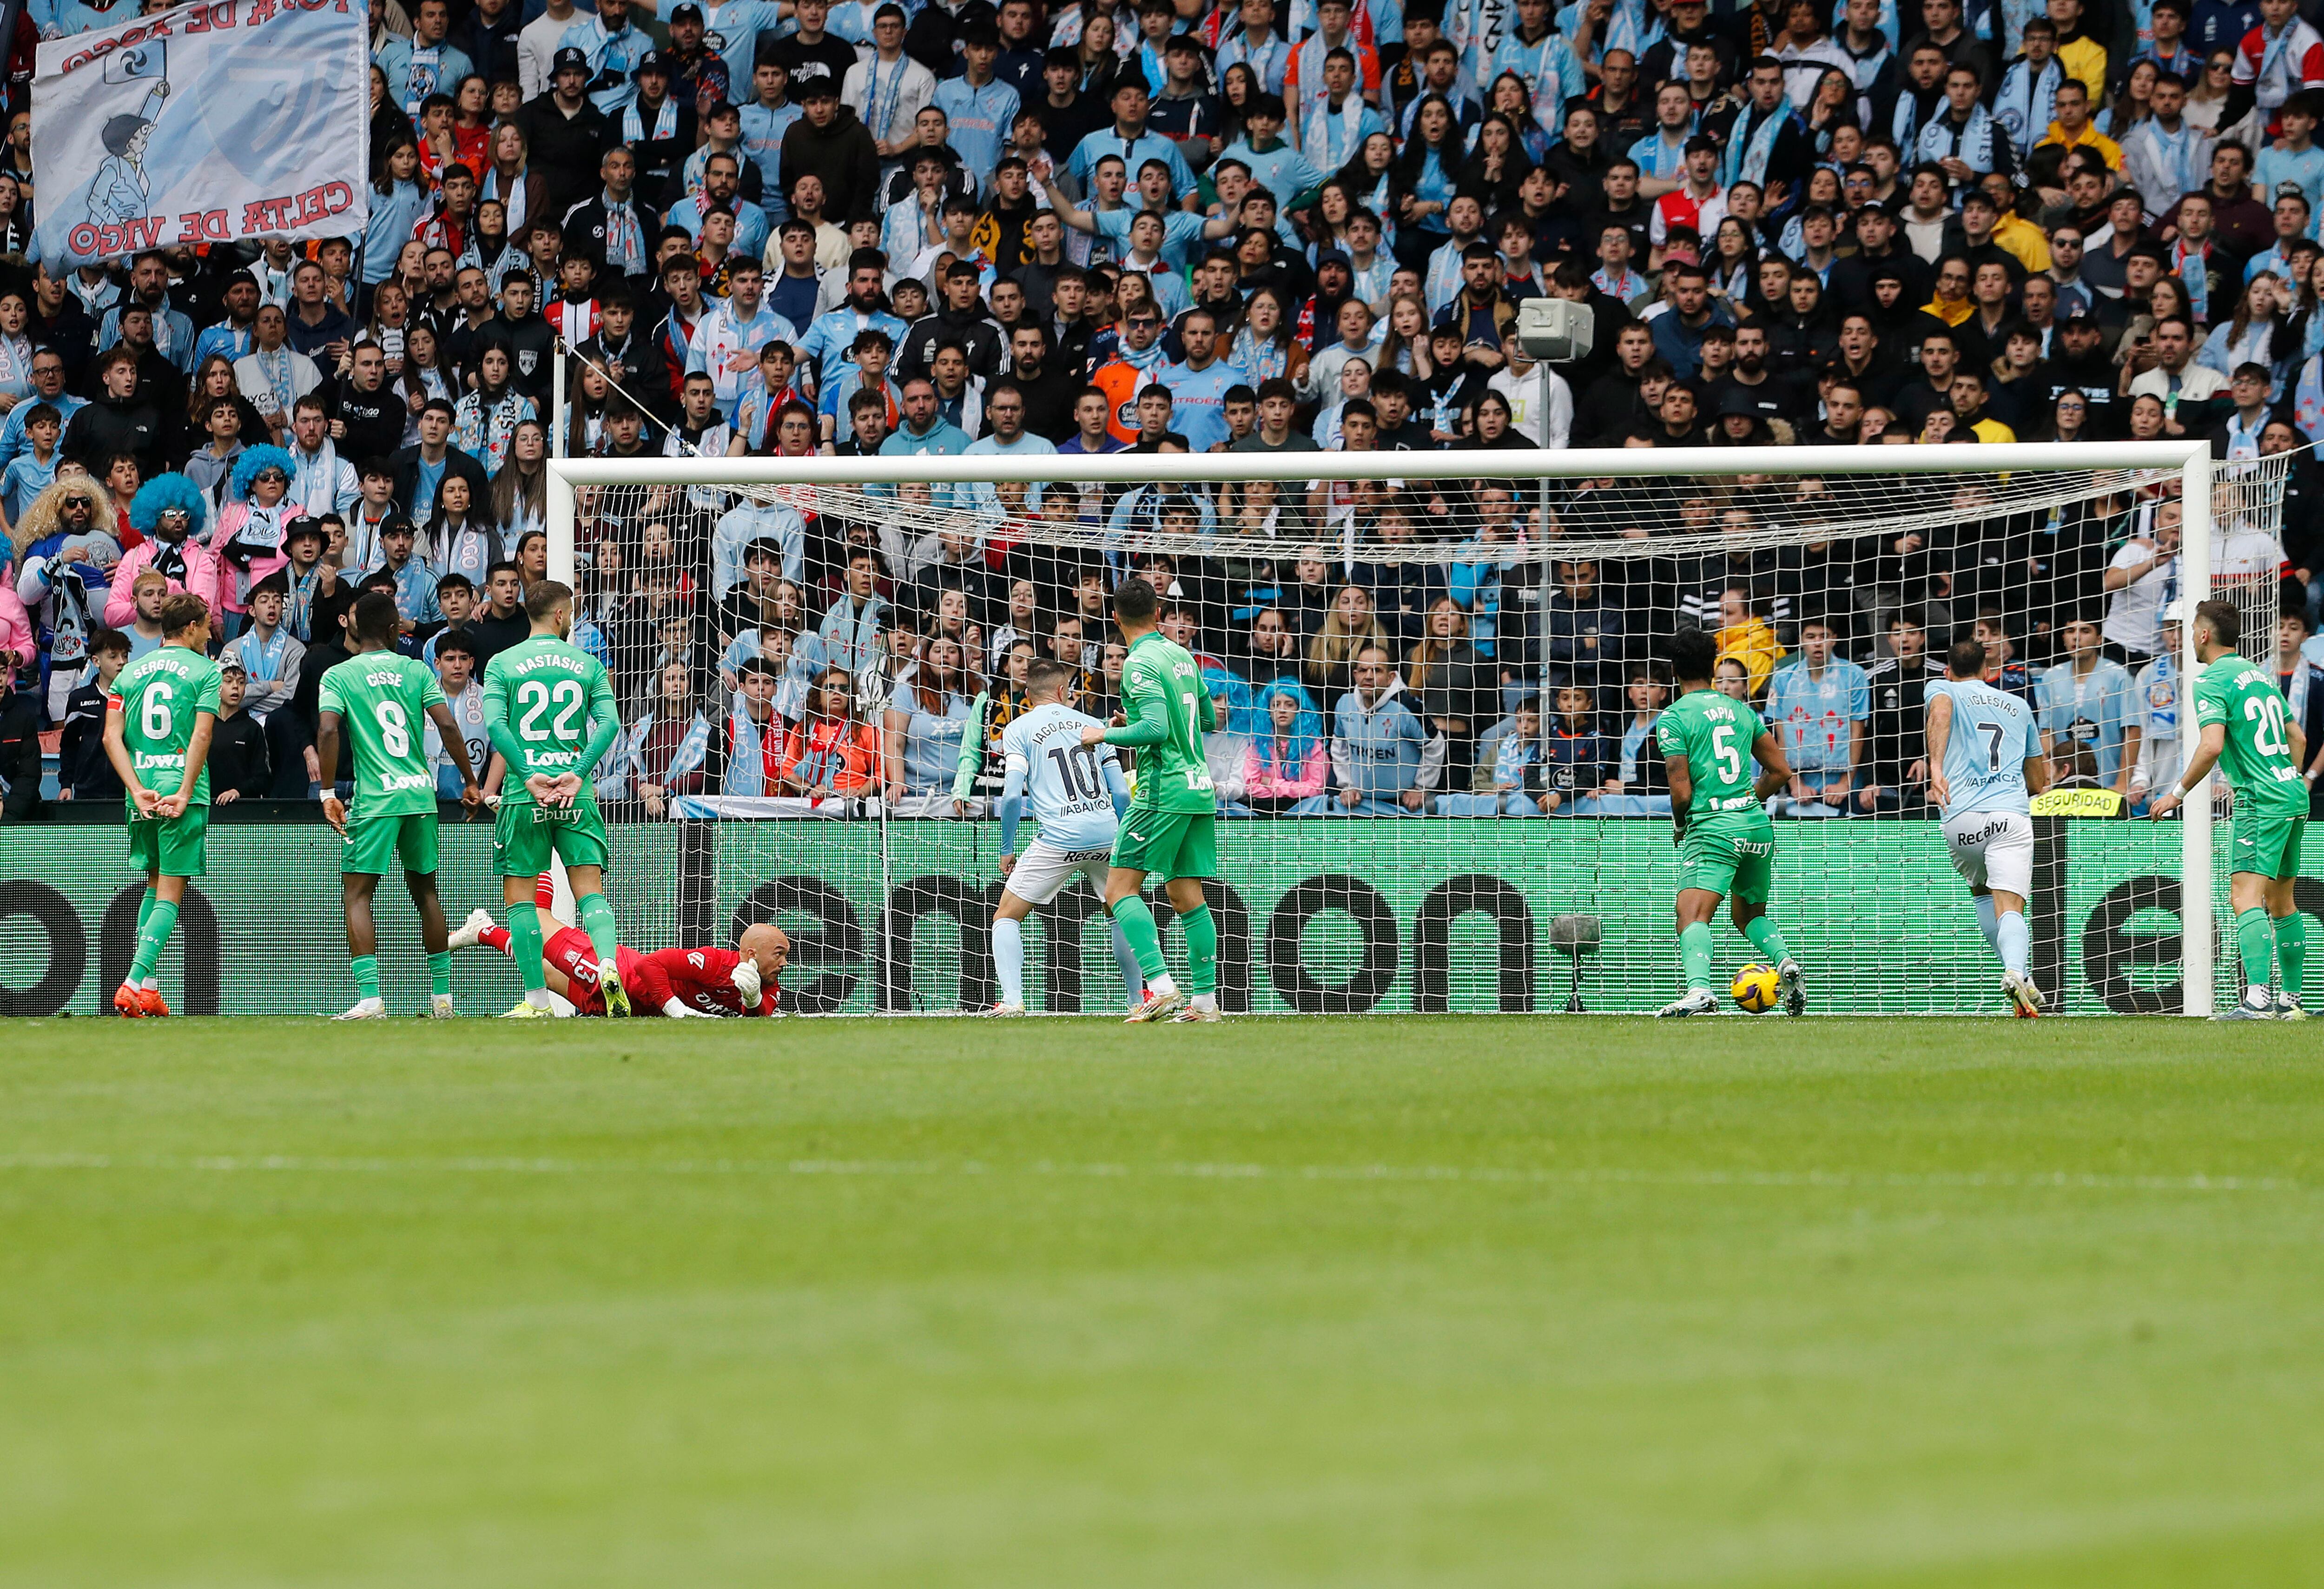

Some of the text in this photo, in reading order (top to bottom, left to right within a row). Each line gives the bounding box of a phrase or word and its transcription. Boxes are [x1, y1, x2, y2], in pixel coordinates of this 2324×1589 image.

[133, 658, 189, 680] SERGIO G.
[515, 654, 585, 675] NASTASIĆ
[366, 671, 403, 688] CISSE
[142, 681, 175, 741] 6
[517, 680, 585, 741] 22
[1702, 706, 1736, 722] TAPIA
[376, 699, 410, 758] 8
[1032, 724, 1058, 745] IAGO
[1182, 692, 1199, 758] 7
[2244, 695, 2291, 757] 20
[134, 748, 186, 769] Lowi
[1711, 725, 1740, 785] 5
[1975, 722, 2005, 772] 7
[1047, 745, 1103, 803] 10
[2037, 791, 2113, 811] SEGURIDAD
[531, 807, 583, 824] Ebury
[1958, 818, 2008, 847] Recalvi
[1732, 837, 1772, 858] Ebury
